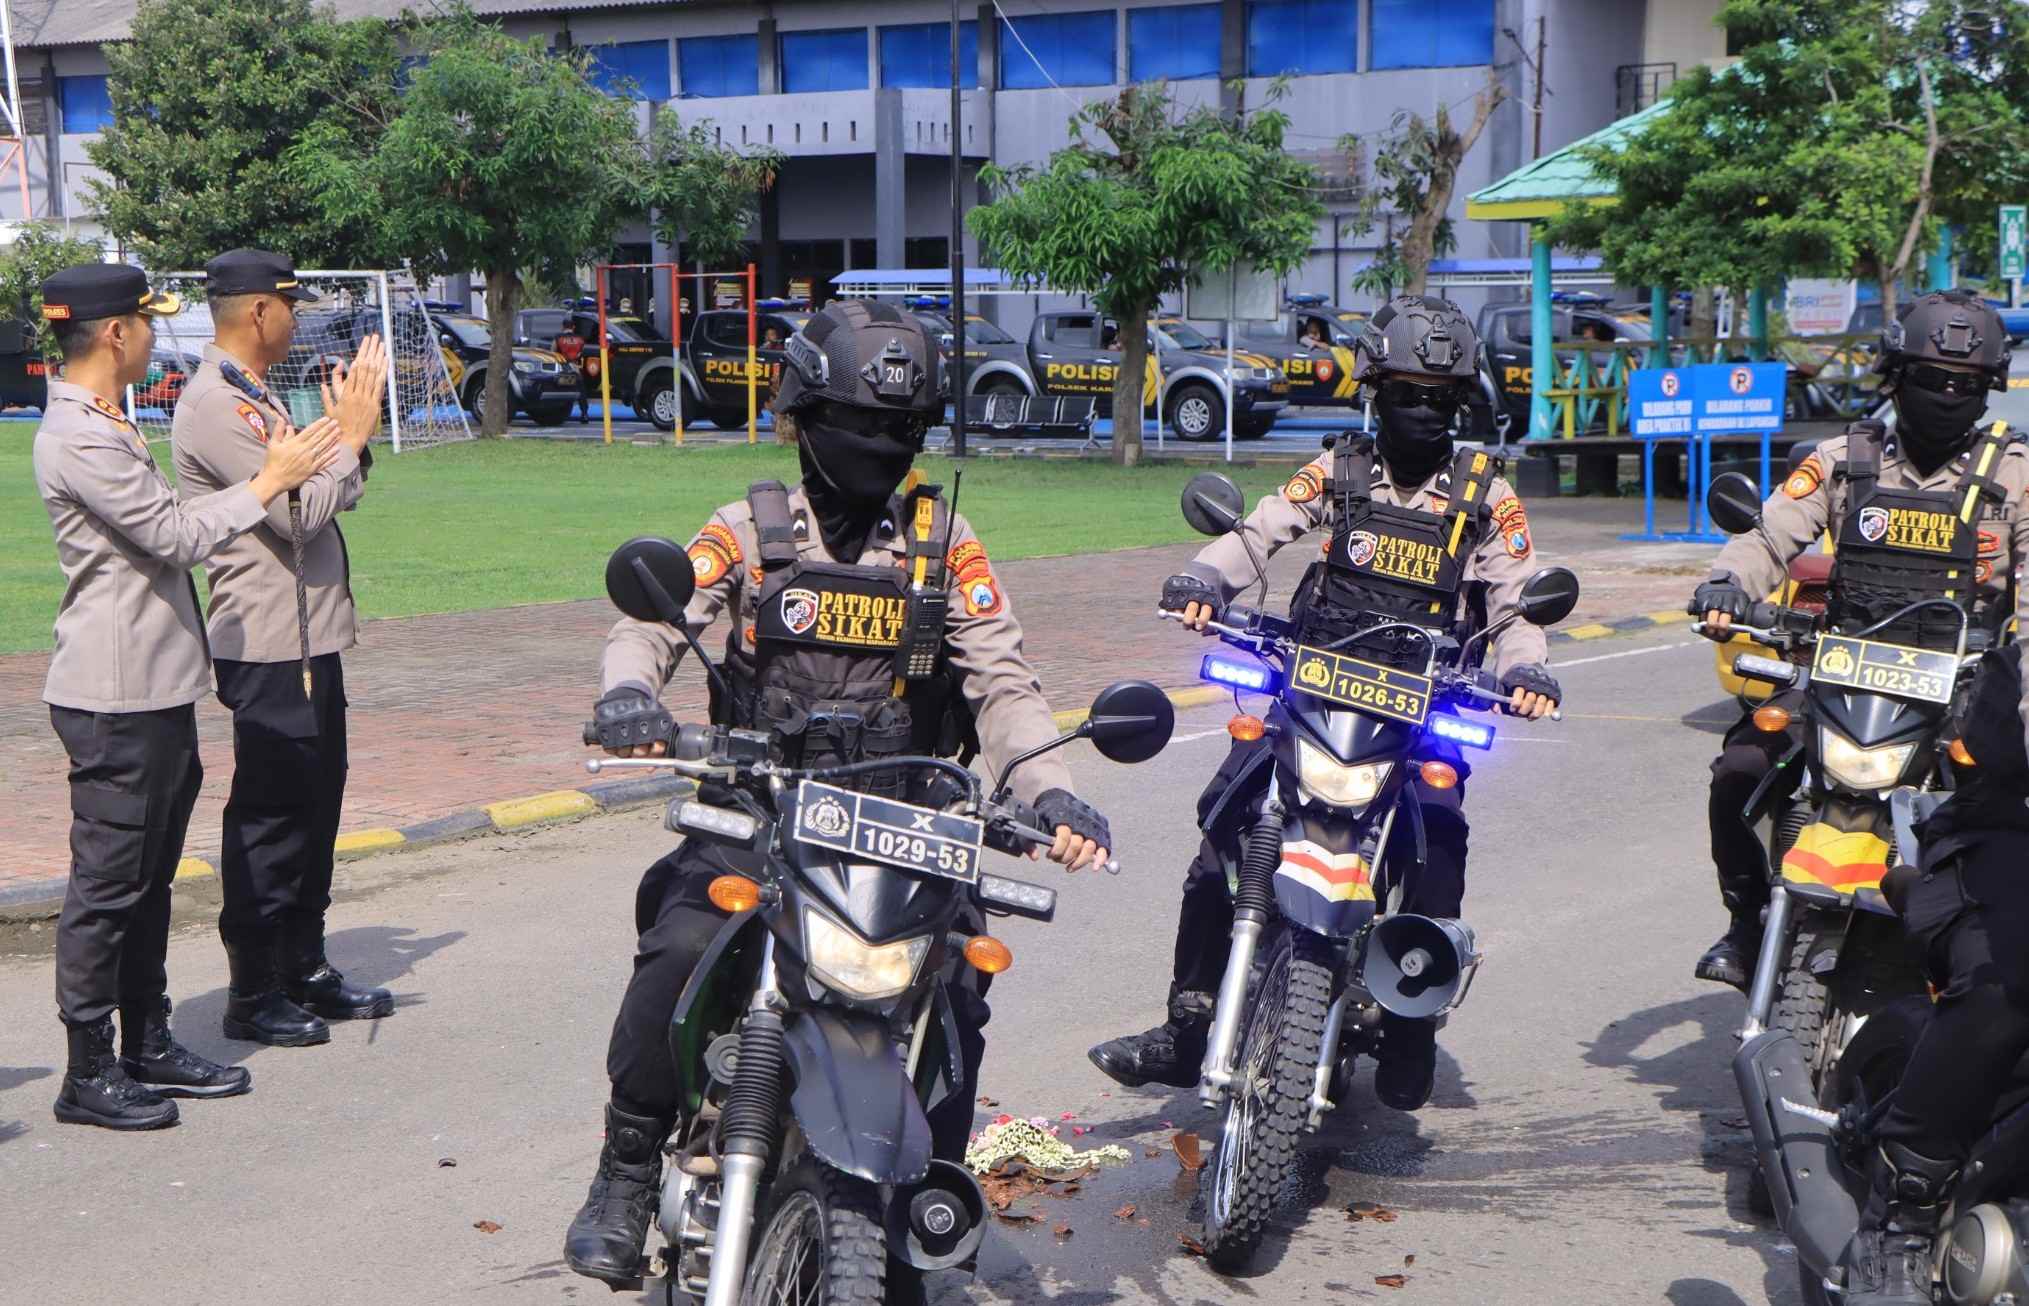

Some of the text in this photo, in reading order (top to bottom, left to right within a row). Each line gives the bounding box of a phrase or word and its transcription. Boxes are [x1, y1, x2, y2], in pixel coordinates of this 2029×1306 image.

[886, 366, 904, 383] 20
[1888, 508, 1957, 532] PATROLI
[1377, 534, 1444, 564] PATROLI
[1887, 525, 1955, 548] SIKAT
[1374, 551, 1440, 580] SIKAT
[819, 591, 906, 620] PATROLI
[817, 612, 904, 641] SIKAT
[1897, 650, 1919, 666] X
[1377, 670, 1388, 682] X
[1863, 666, 1943, 697] 1023-53
[1338, 678, 1420, 715] 1026-53
[910, 812, 935, 833] X
[864, 827, 969, 873] 1029-53
